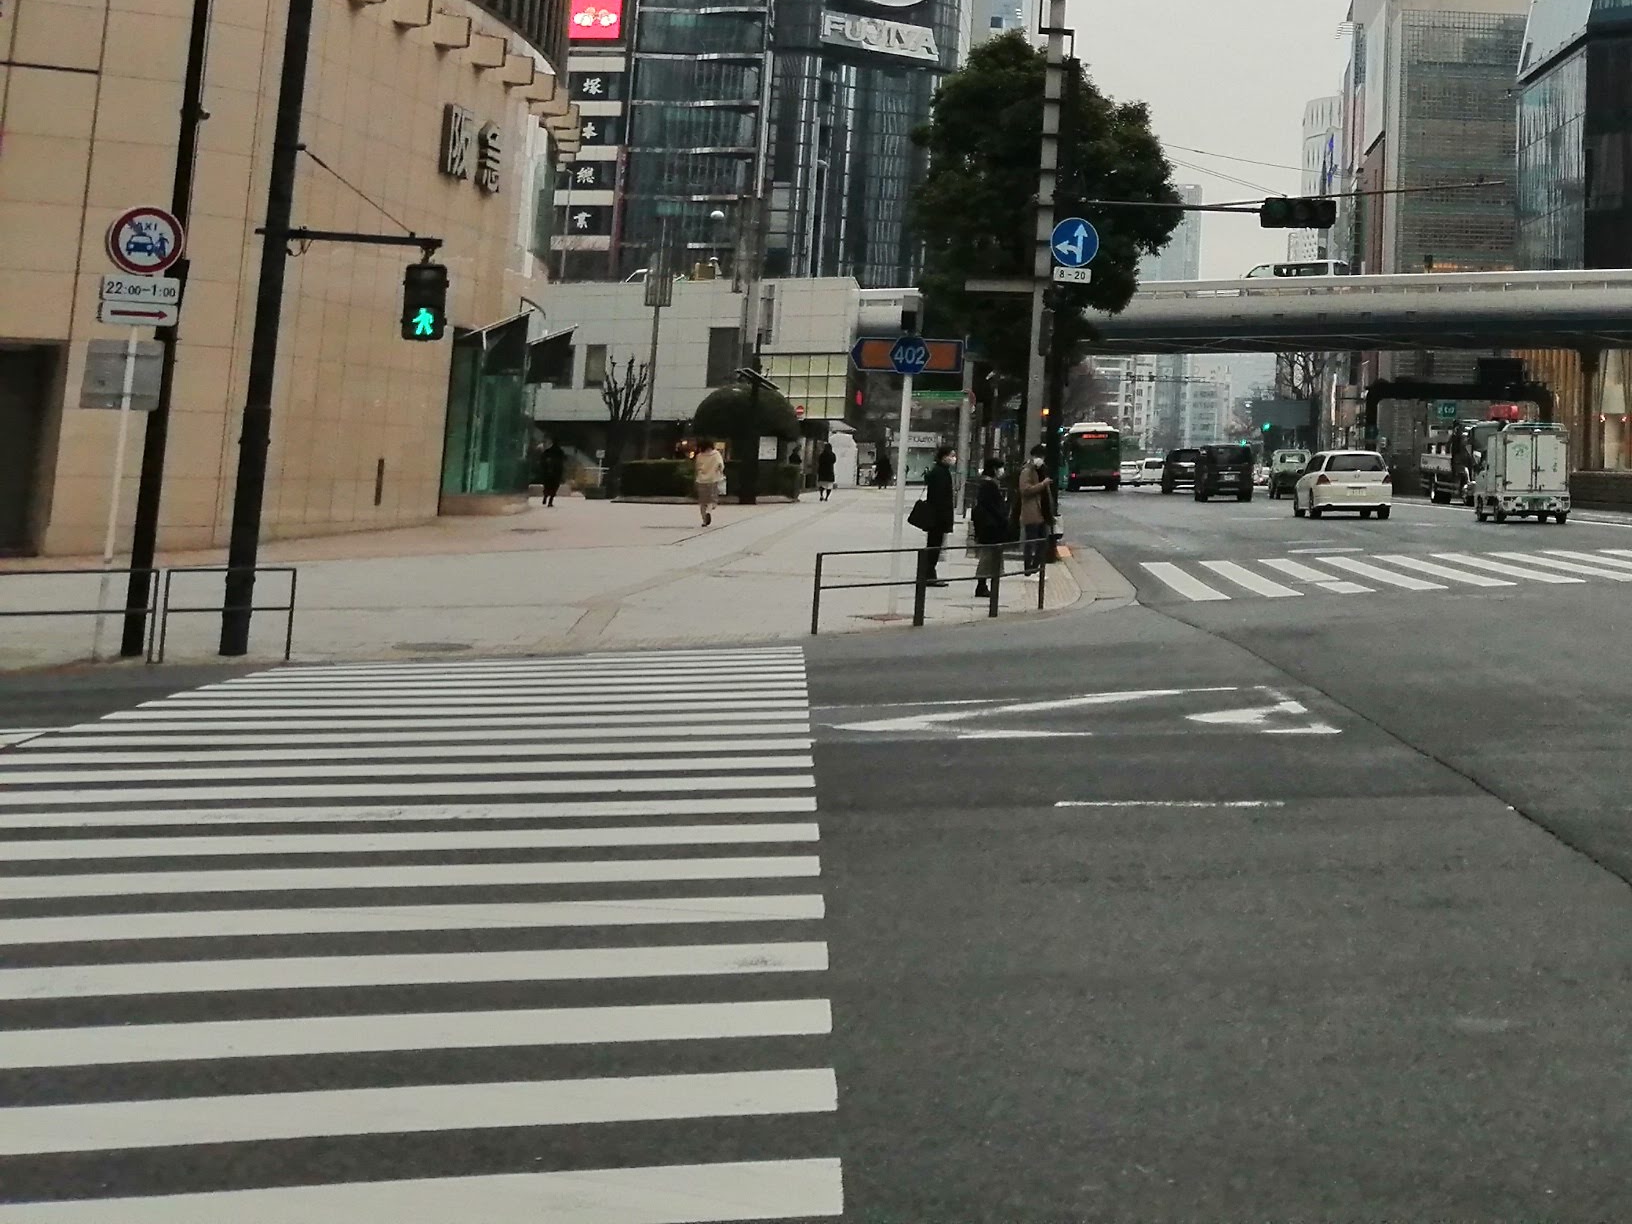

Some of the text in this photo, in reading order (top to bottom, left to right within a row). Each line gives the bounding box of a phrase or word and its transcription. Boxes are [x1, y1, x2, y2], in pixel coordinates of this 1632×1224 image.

[821, 13, 940, 57] FUJIYA
[105, 280, 176, 297] 22:00-1:00
[894, 346, 925, 365] 402
